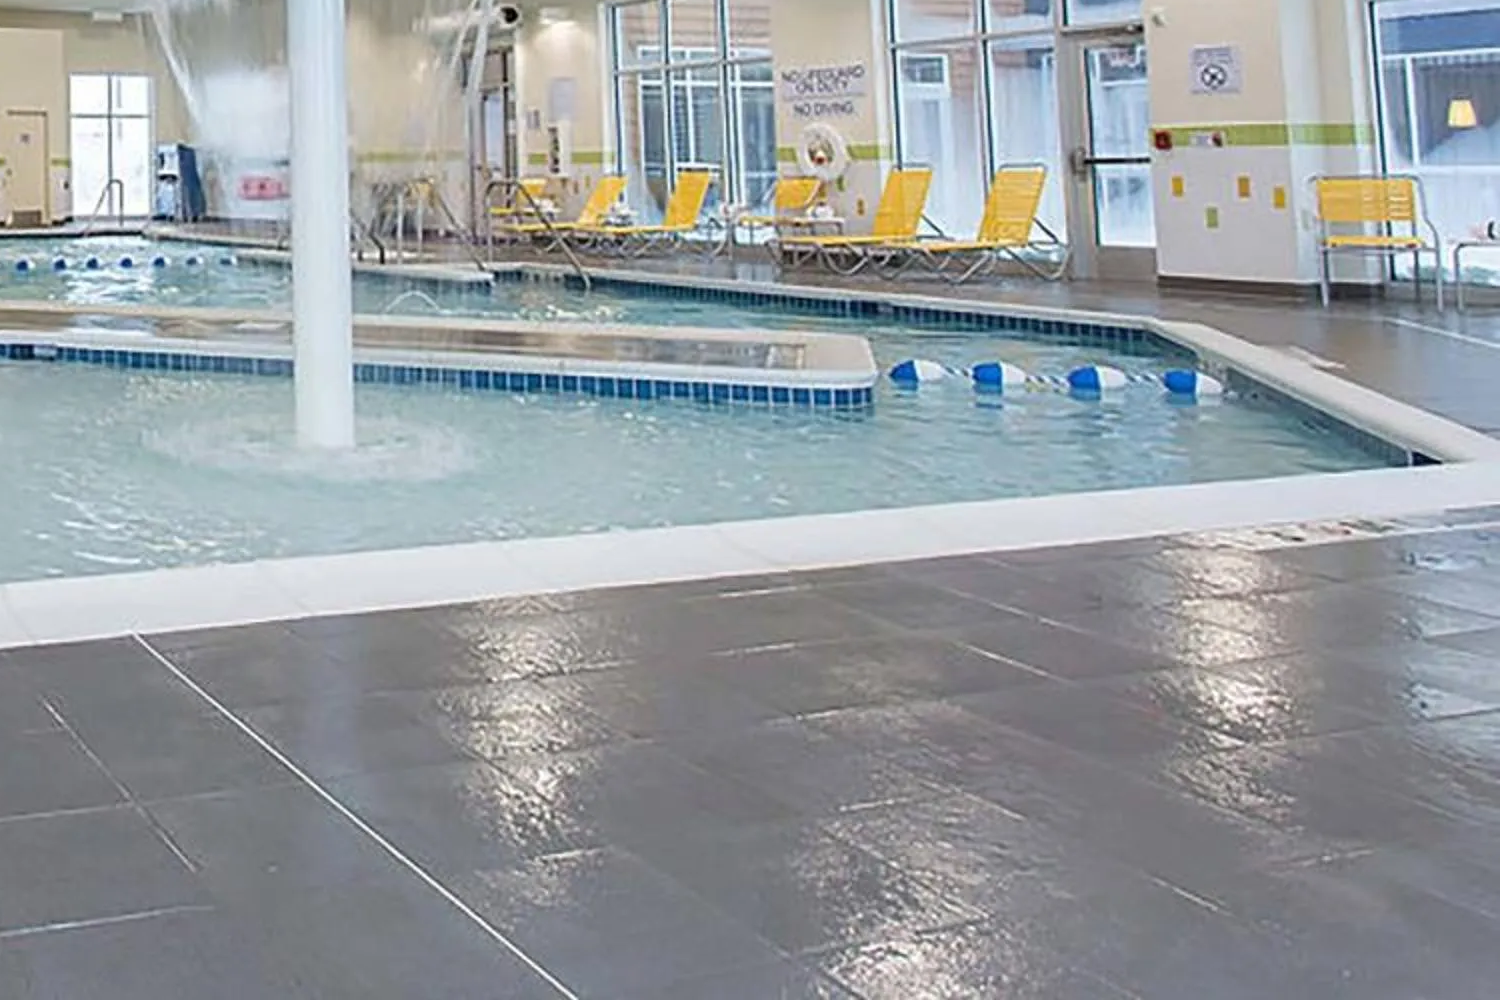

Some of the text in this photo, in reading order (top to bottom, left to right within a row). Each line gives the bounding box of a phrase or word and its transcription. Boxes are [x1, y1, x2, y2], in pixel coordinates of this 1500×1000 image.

[781, 69, 800, 83] NO
[795, 79, 848, 94] ON DUTY
[793, 101, 855, 117] NO DIVING
